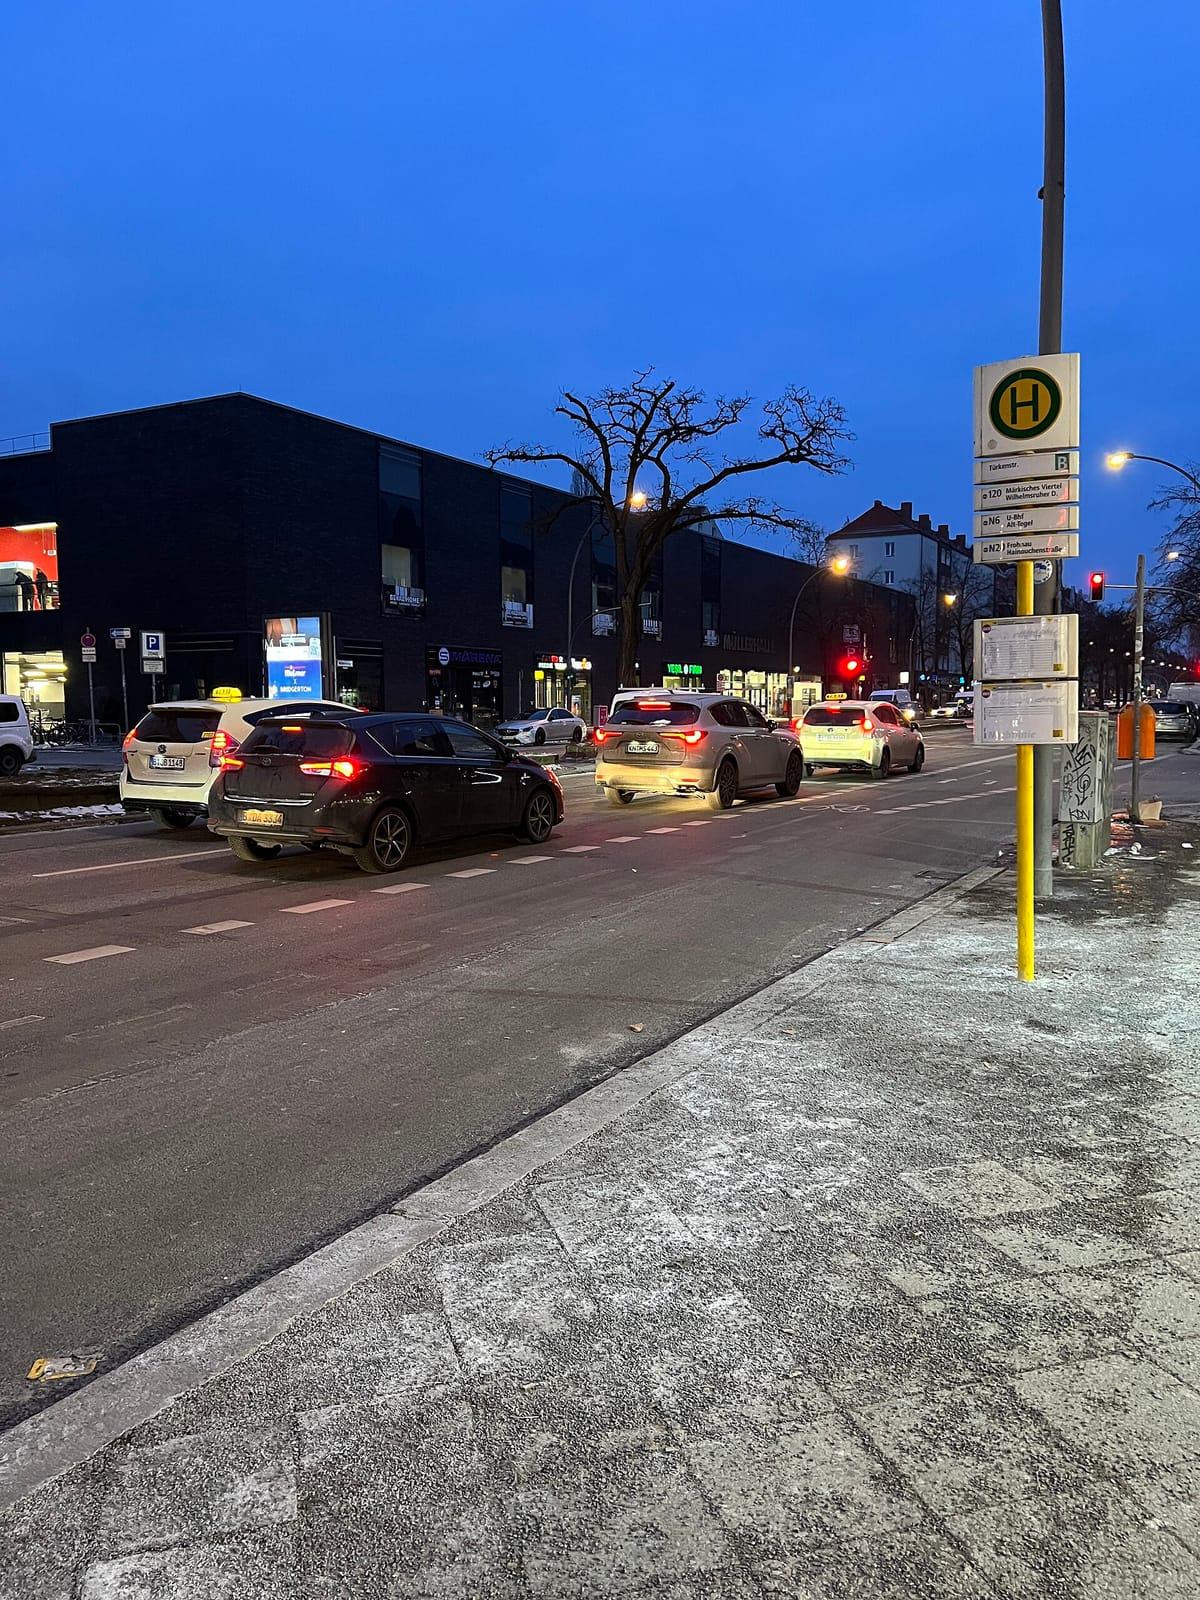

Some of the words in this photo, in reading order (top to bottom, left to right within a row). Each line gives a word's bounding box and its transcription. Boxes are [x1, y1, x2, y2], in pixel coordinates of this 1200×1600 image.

[1010, 384, 1039, 425] H
[989, 461, 1019, 471] Türkenstr.
[1058, 456, 1068, 468] B
[988, 489, 1002, 498] 120
[1006, 485, 1040, 493] Märkisches
[1006, 492, 1050, 500] Wilhelmsruher
[988, 516, 1000, 525] N6
[1006, 520, 1033, 528] Alt-Tegel
[149, 637, 157, 648] P
